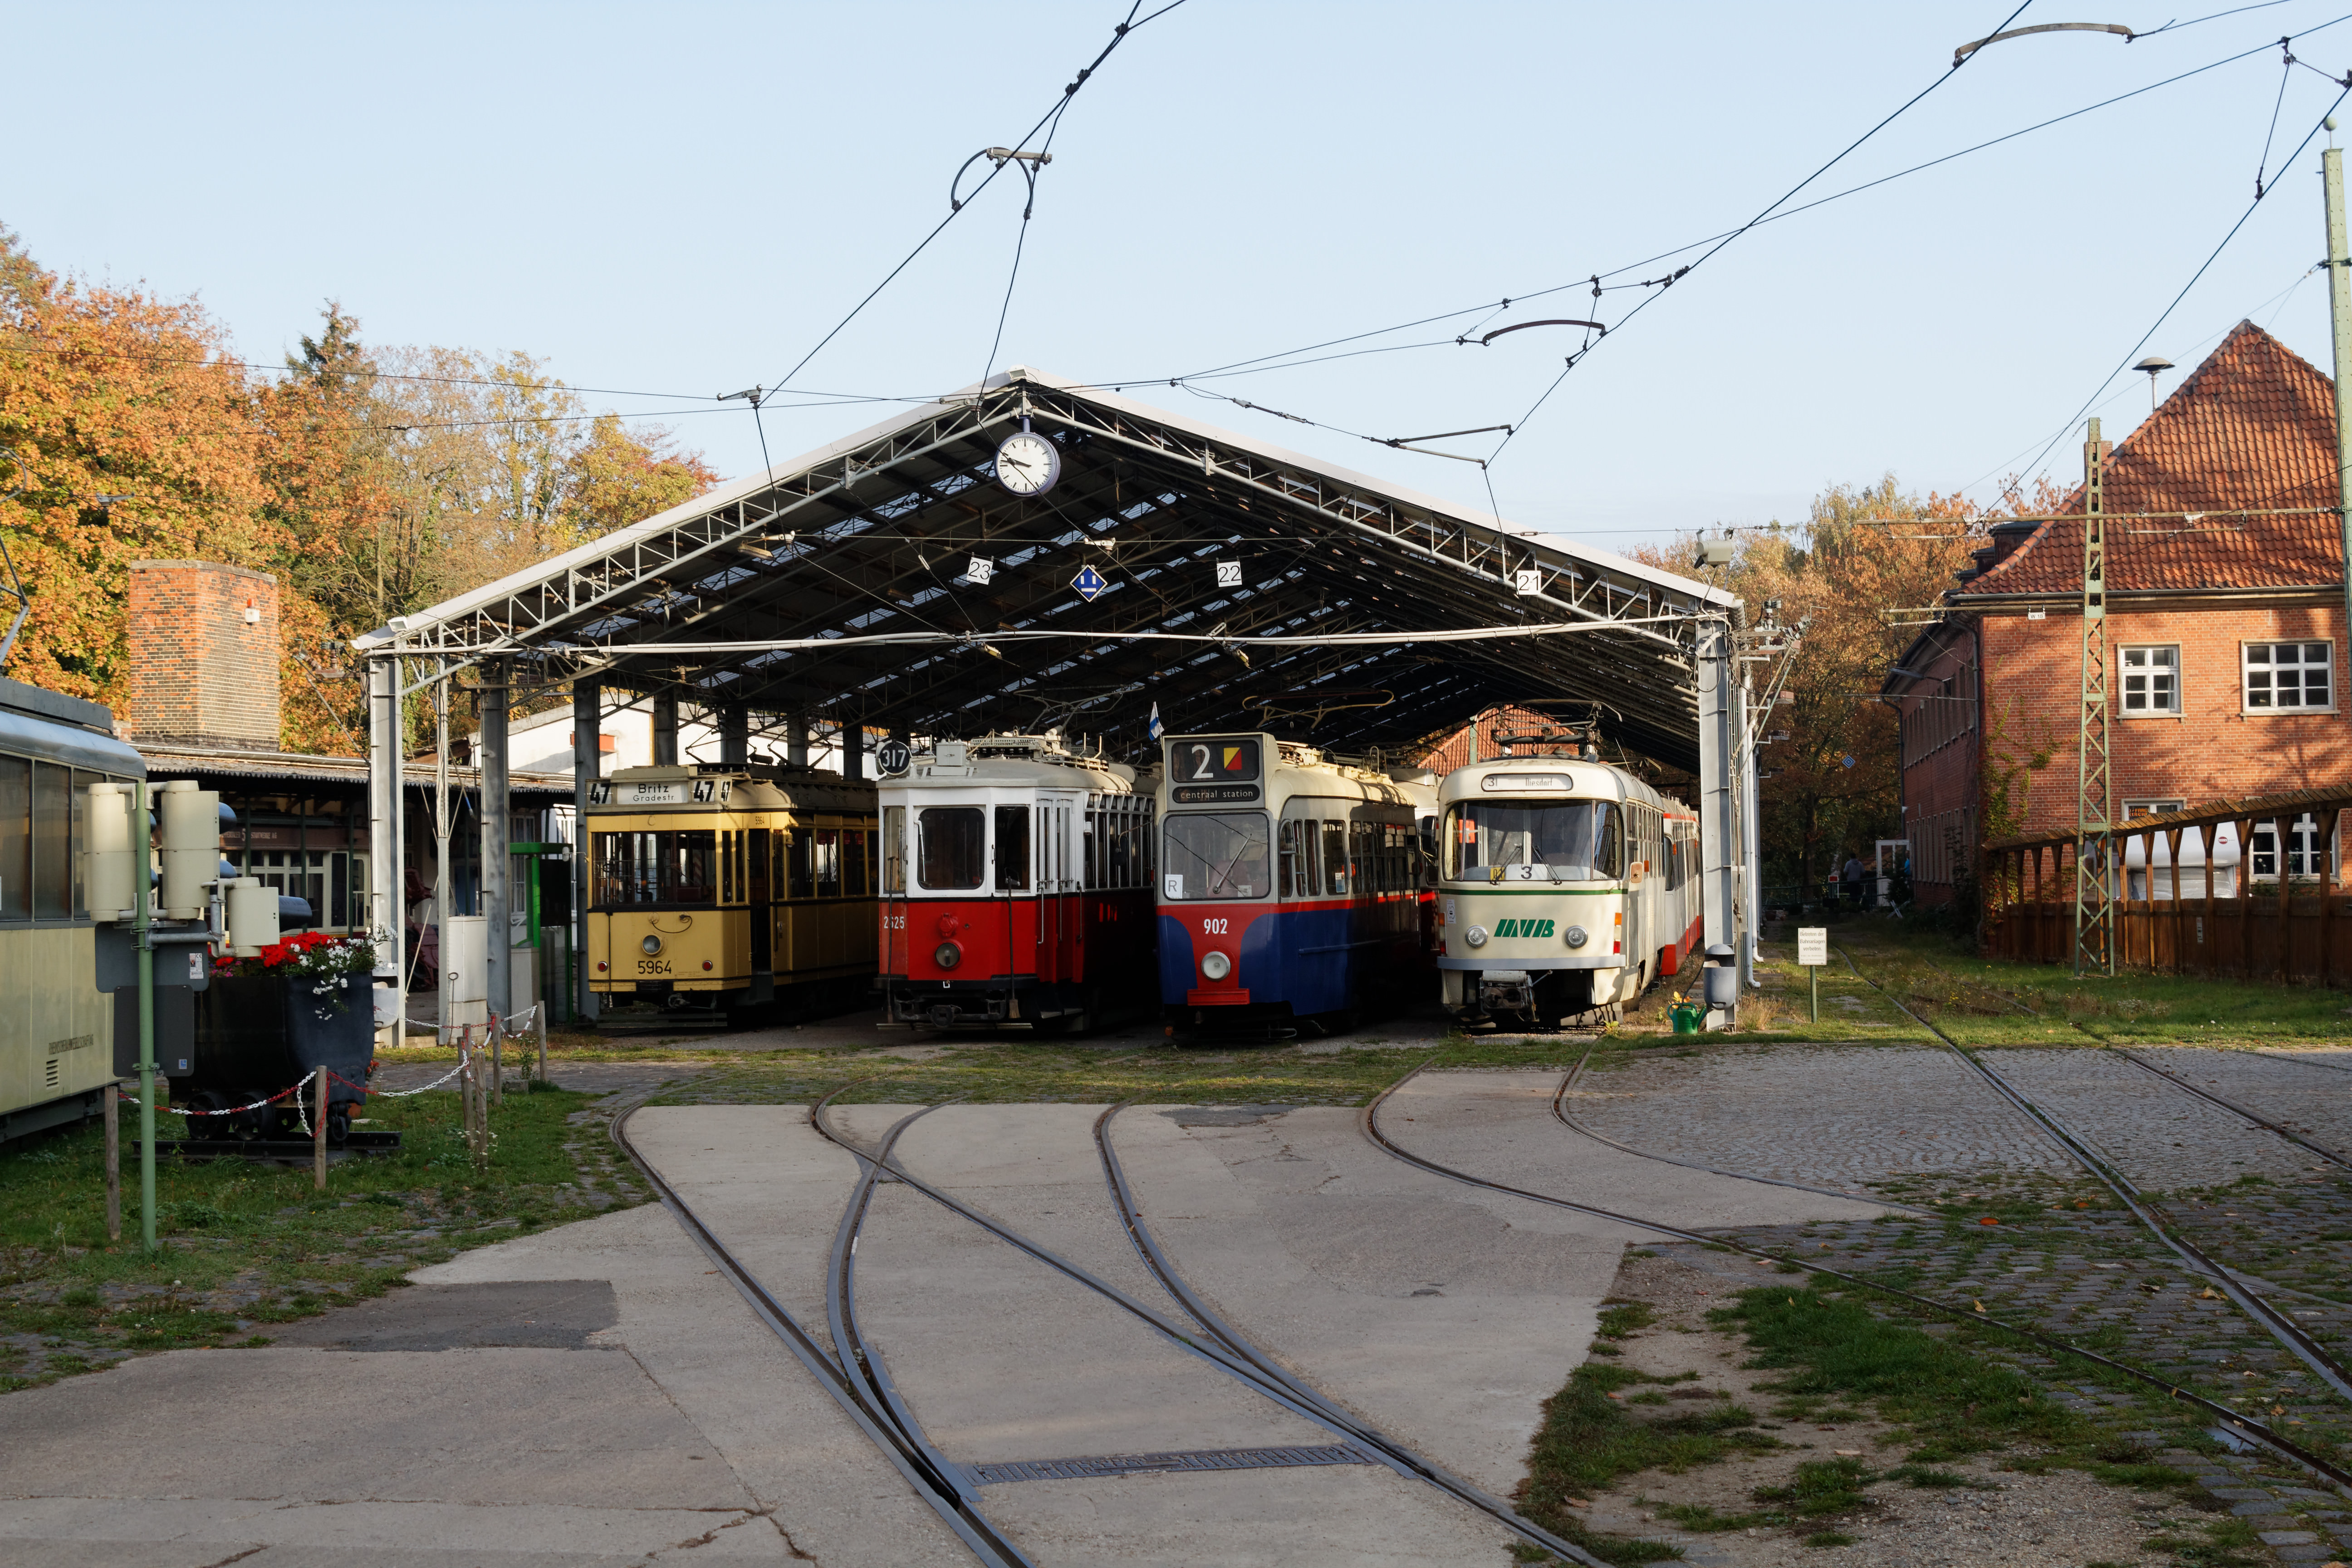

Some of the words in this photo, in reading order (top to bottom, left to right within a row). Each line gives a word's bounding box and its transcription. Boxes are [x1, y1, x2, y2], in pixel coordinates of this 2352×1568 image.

[968, 562, 990, 580] 23
[1218, 565, 1241, 583] 22
[1519, 575, 1538, 591] 21
[882, 749, 906, 767] 317
[1191, 745, 1214, 779] 2
[590, 783, 611, 804] 47
[638, 783, 669, 794] Britz
[693, 781, 715, 802] 47
[721, 781, 730, 802] 47
[1181, 790, 1217, 799] centraal
[755, 816, 765, 825] 5964
[1520, 866, 1532, 879] 3
[1168, 880, 1177, 892] R
[1204, 918, 1228, 934] 902
[638, 960, 671, 974] 5964
